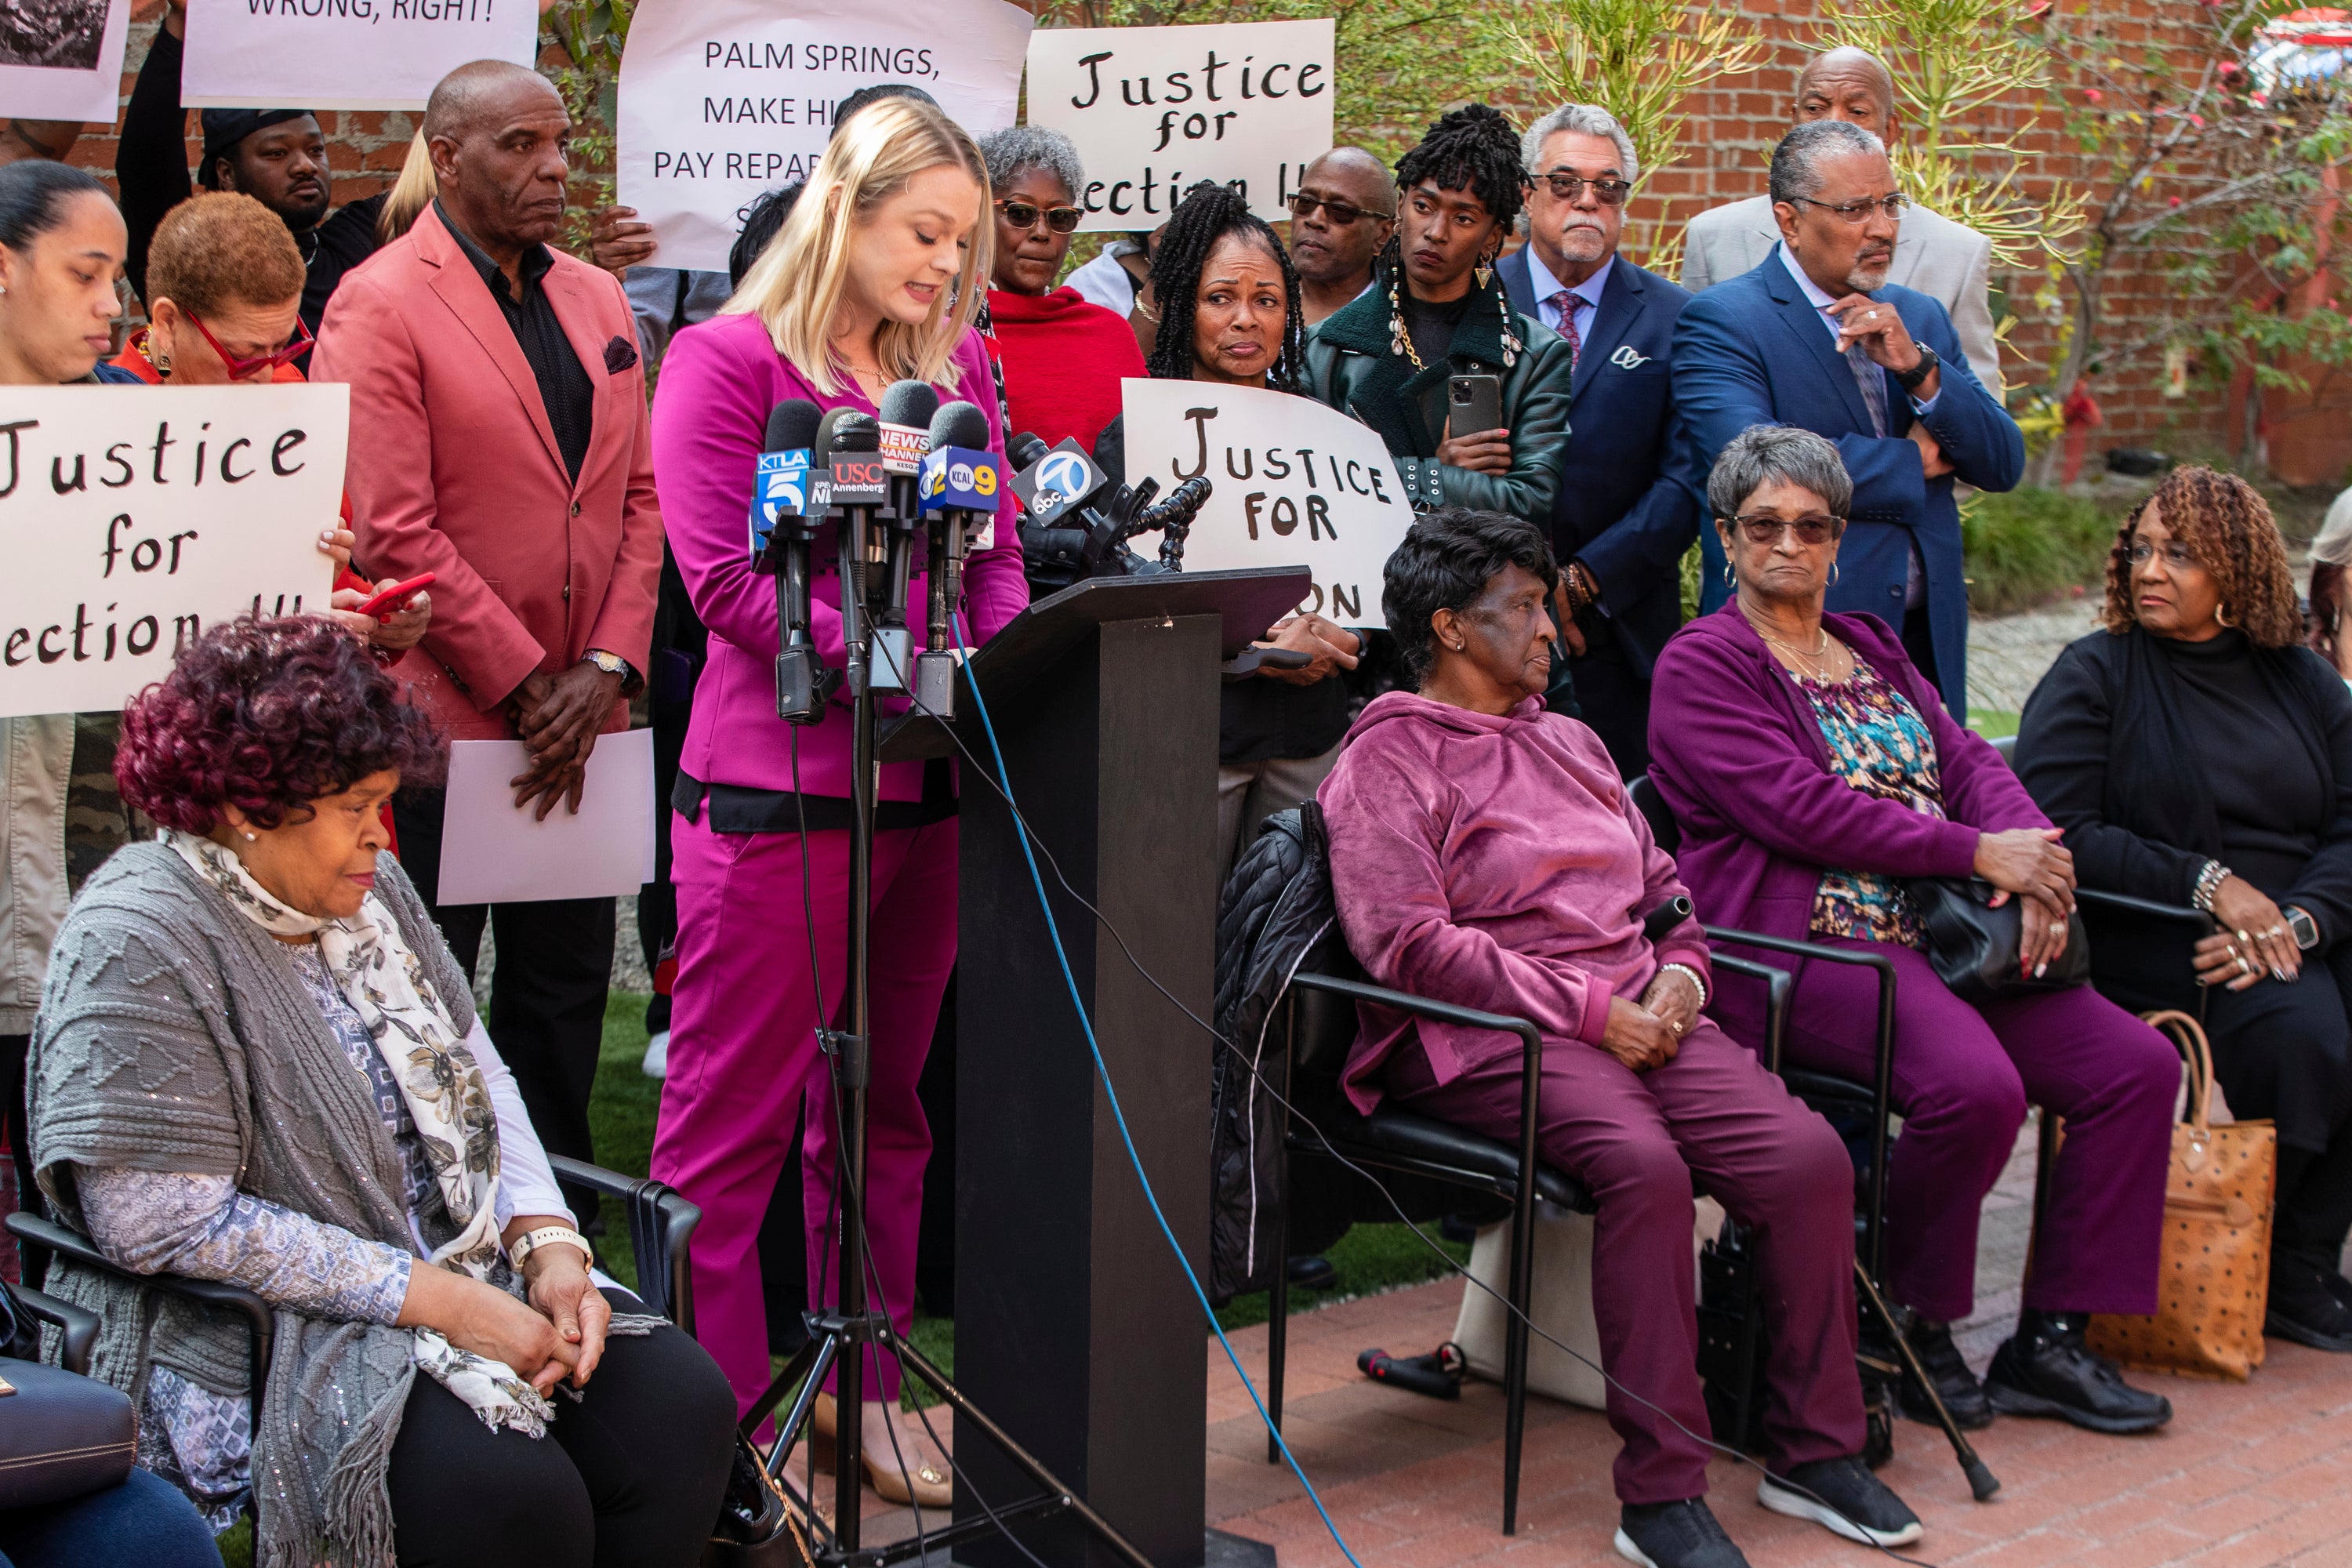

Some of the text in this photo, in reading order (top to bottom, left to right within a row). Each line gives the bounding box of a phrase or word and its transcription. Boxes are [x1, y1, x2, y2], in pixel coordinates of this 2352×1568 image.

[248, 0, 493, 24] WRONG, RIGHT!
[706, 42, 940, 81] PALM SPRINGS,
[1071, 51, 1326, 109] Justice
[704, 97, 834, 126] MAKE HI
[1152, 111, 1238, 152] for
[654, 152, 714, 179] PAY
[0, 419, 307, 499] Justice
[760, 451, 807, 470] KTLA
[834, 463, 884, 484] USC
[1172, 406, 1392, 504] JUSTICE
[763, 470, 804, 525] 5
[833, 482, 884, 494] Annenberg
[933, 462, 946, 496] 2
[952, 465, 996, 495] KCAL 9
[1034, 492, 1062, 514] abc
[1244, 491, 1338, 541] FOR
[100, 513, 199, 579] for
[1294, 582, 1361, 619] ON
[4, 601, 202, 667] ection
